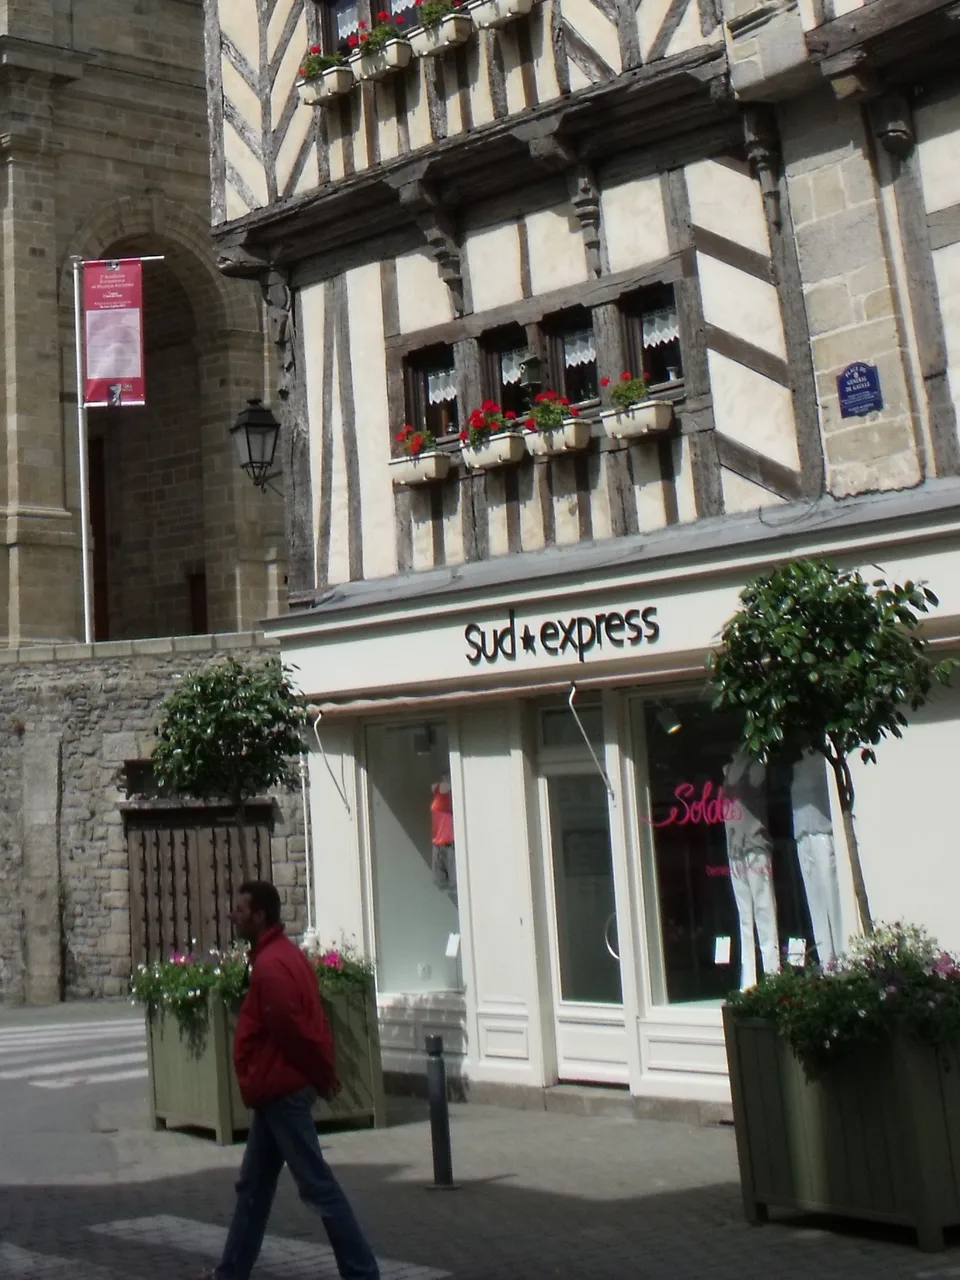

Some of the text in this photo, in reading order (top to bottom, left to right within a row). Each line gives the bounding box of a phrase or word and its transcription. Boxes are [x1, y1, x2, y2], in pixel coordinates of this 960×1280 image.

[464, 606, 660, 665] sud express
[646, 781, 745, 826] Soldes
